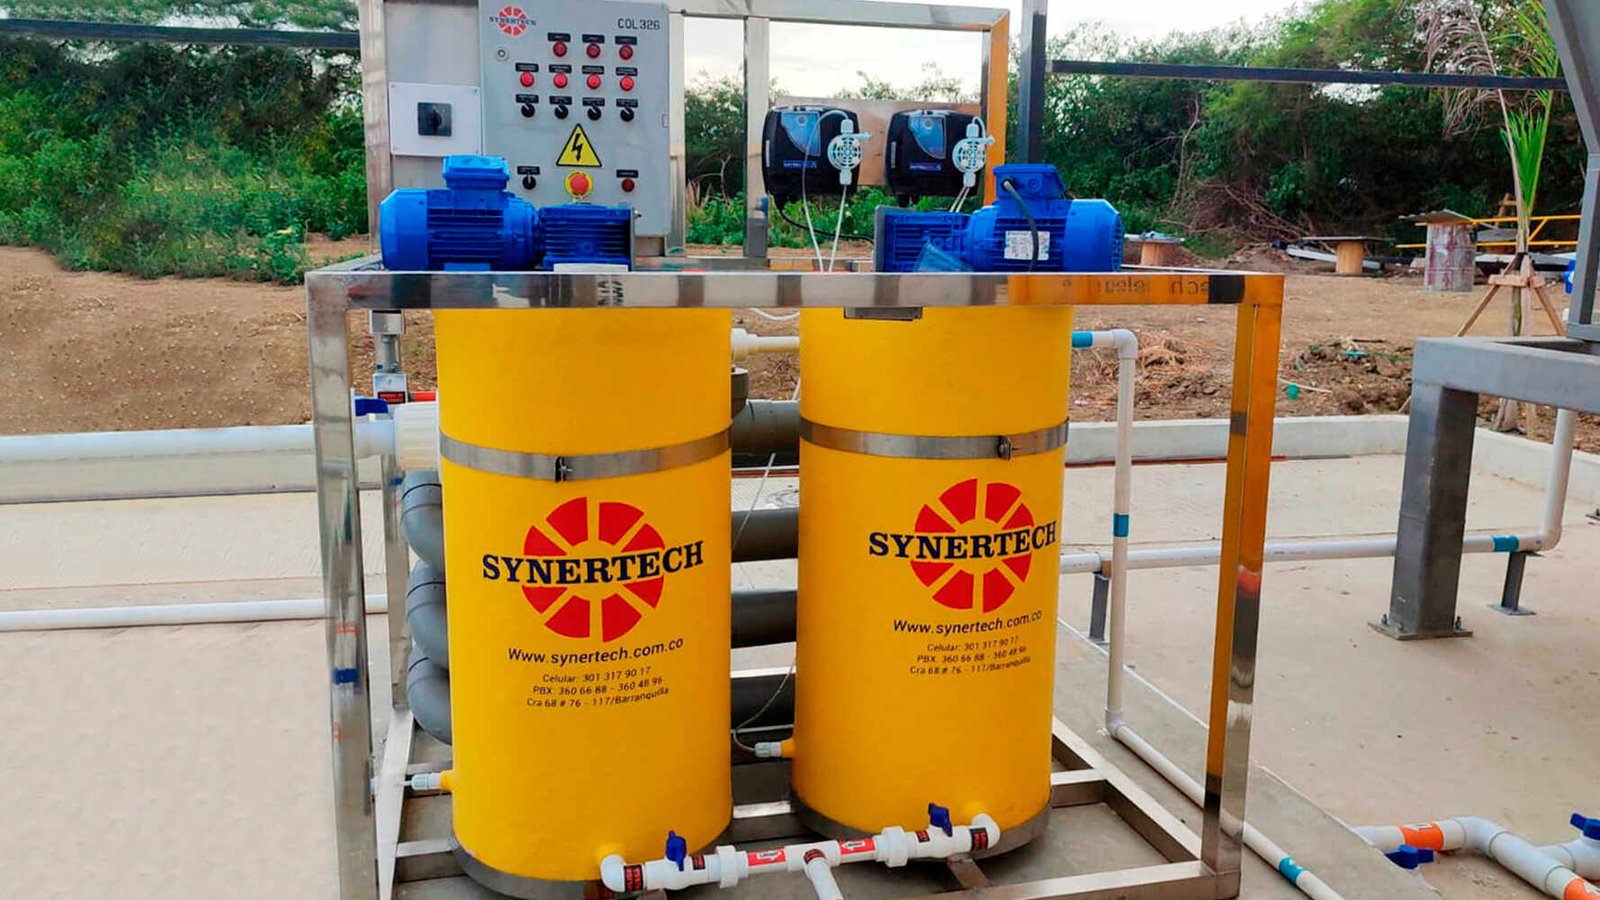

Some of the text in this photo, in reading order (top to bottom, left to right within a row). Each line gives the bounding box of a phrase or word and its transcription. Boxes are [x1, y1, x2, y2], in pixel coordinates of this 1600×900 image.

[868, 520, 1057, 560] SYNERTECH
[482, 540, 704, 585] SYNERTECH
[893, 610, 1042, 637] Www.synertech.com.co
[508, 637, 684, 667] Www.synertech.com.co
[964, 642, 979, 652] 301
[942, 654, 958, 663] 360
[961, 654, 971, 662] 66
[974, 653, 985, 662] 88
[582, 672, 600, 682] 301
[604, 671, 622, 681] 317
[625, 669, 637, 678] 90
[640, 666, 651, 676] 17
[909, 666, 926, 675] Cra
[928, 666, 939, 675] 68
[951, 666, 962, 674] 76
[559, 686, 577, 696] 360
[579, 686, 592, 695] 66
[595, 685, 607, 694] 88
[618, 681, 635, 692] 360
[527, 698, 543, 707] Cra
[545, 699, 557, 708] 68
[569, 699, 581, 708] 76
